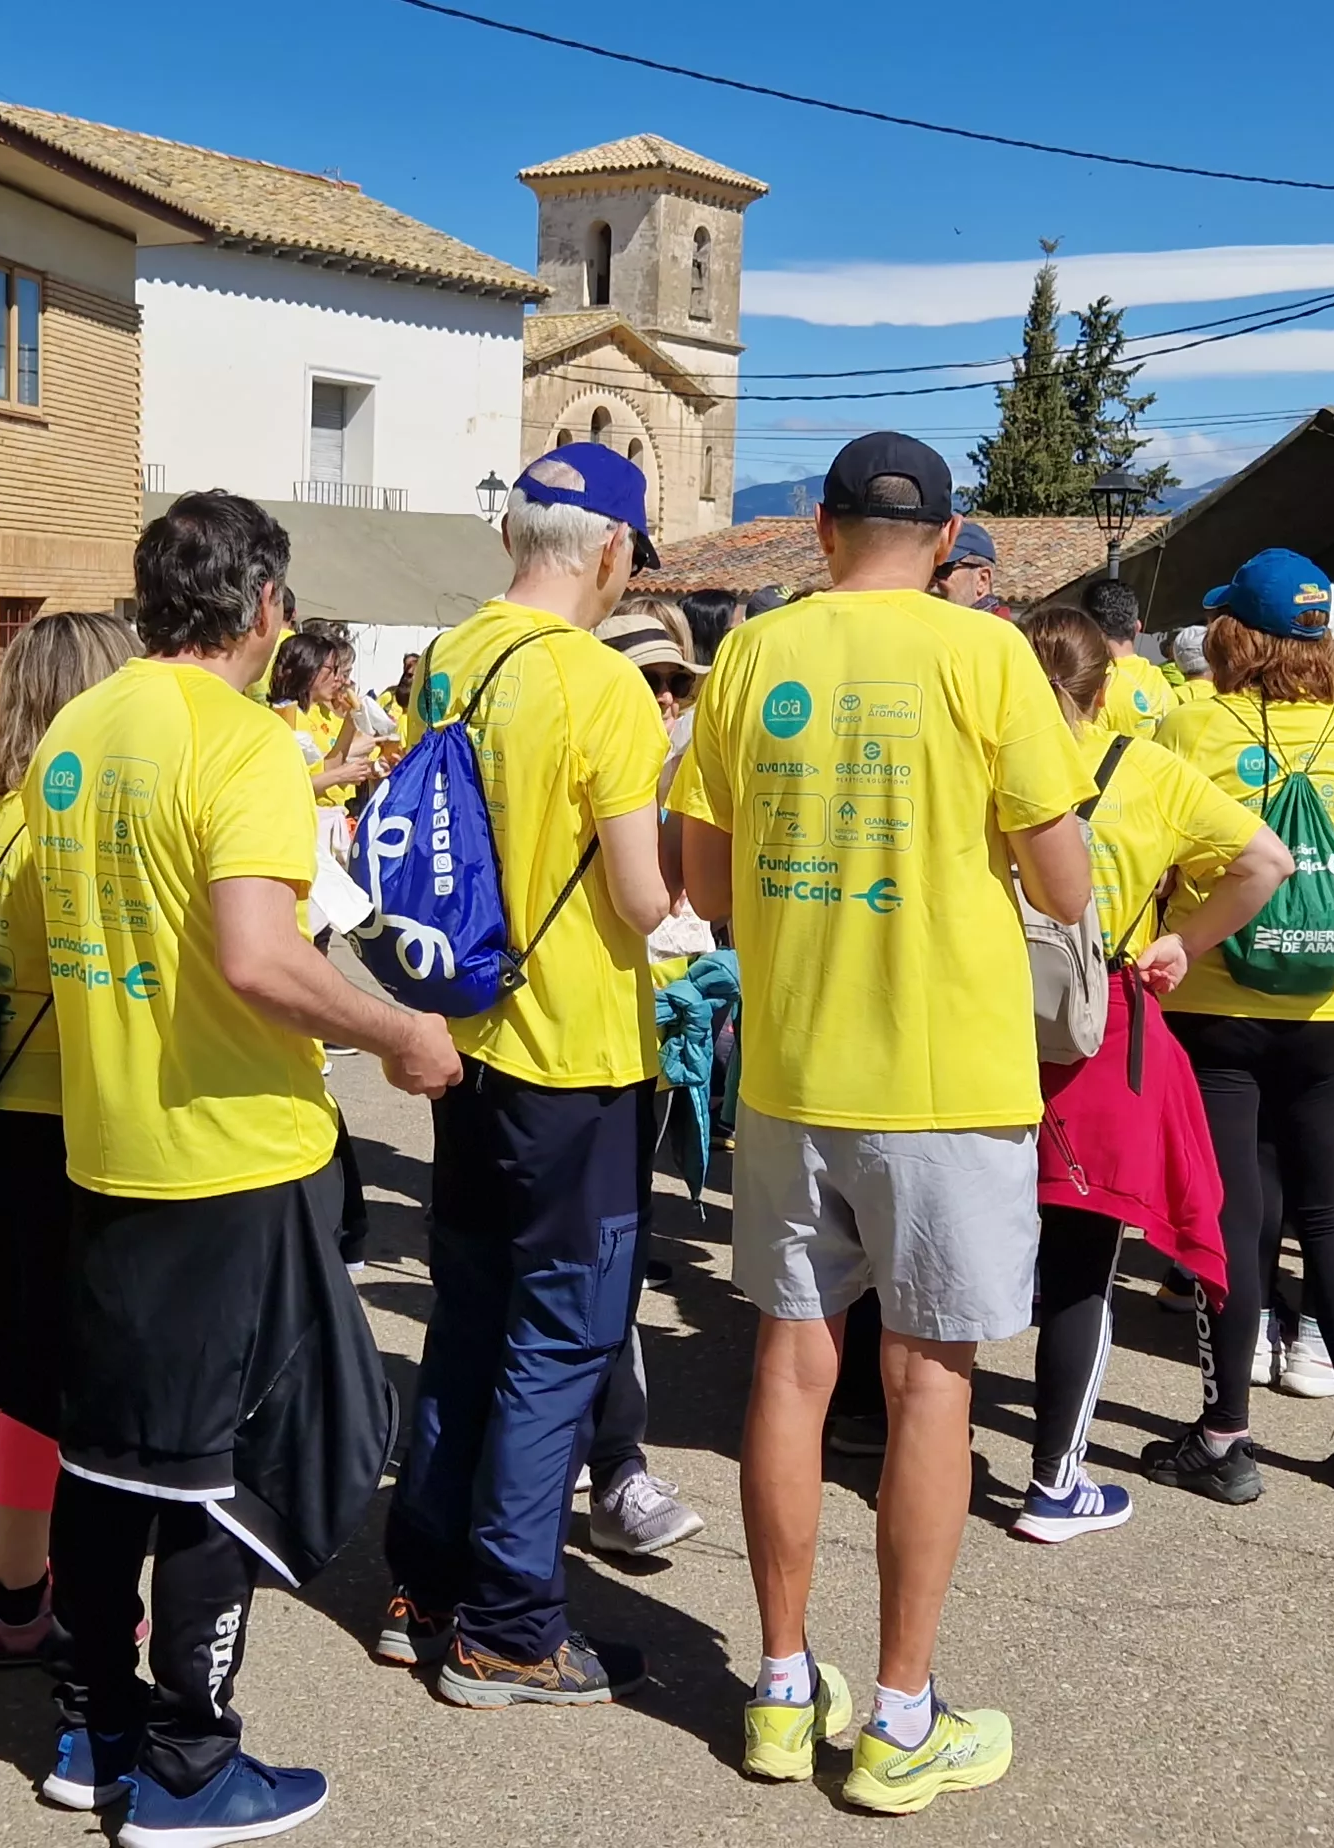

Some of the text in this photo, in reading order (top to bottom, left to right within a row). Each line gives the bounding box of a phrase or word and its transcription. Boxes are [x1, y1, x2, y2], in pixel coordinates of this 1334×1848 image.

[835, 762, 911, 777] escanero
[758, 854, 839, 873] Fundación
[1281, 942, 1301, 954] DE
